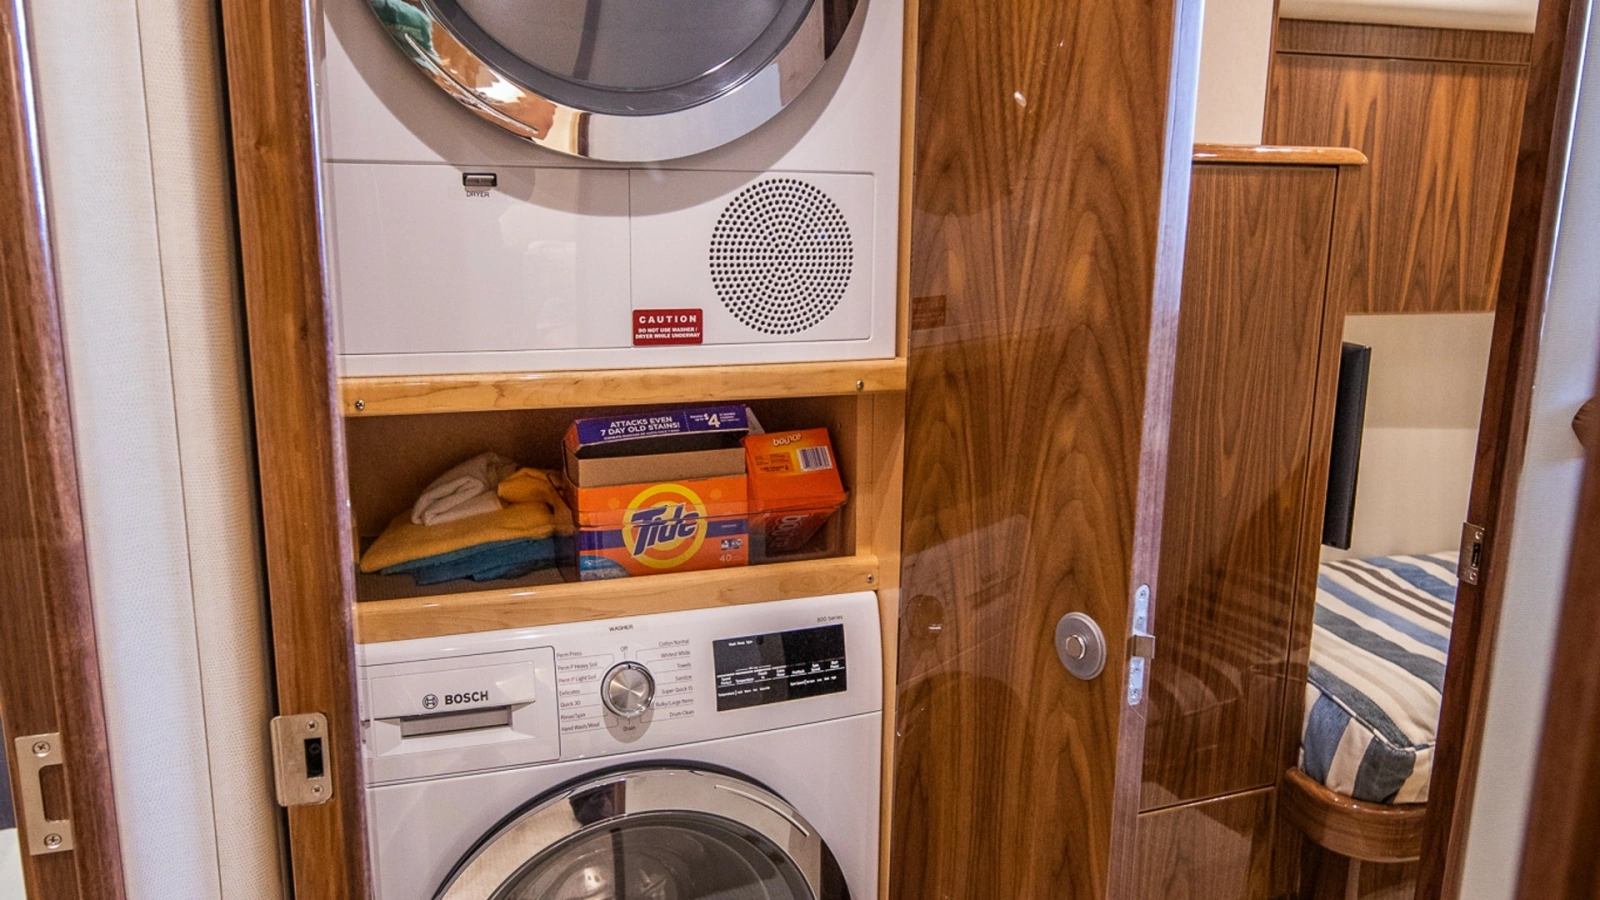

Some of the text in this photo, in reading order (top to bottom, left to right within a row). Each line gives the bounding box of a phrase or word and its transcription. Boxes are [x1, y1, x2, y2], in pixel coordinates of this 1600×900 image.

[466, 190, 490, 198] DRYER
[638, 315, 697, 324] CAUTION
[610, 416, 673, 428] ATTACKS EVEN
[608, 427, 626, 436] DAY
[627, 425, 646, 433] OLD
[647, 422, 681, 431] STAINS!
[773, 433, 802, 446] bounce
[630, 502, 700, 557] Tide
[719, 553, 732, 562] 40
[609, 624, 634, 632] WASHER
[444, 691, 489, 705] BOSCH
